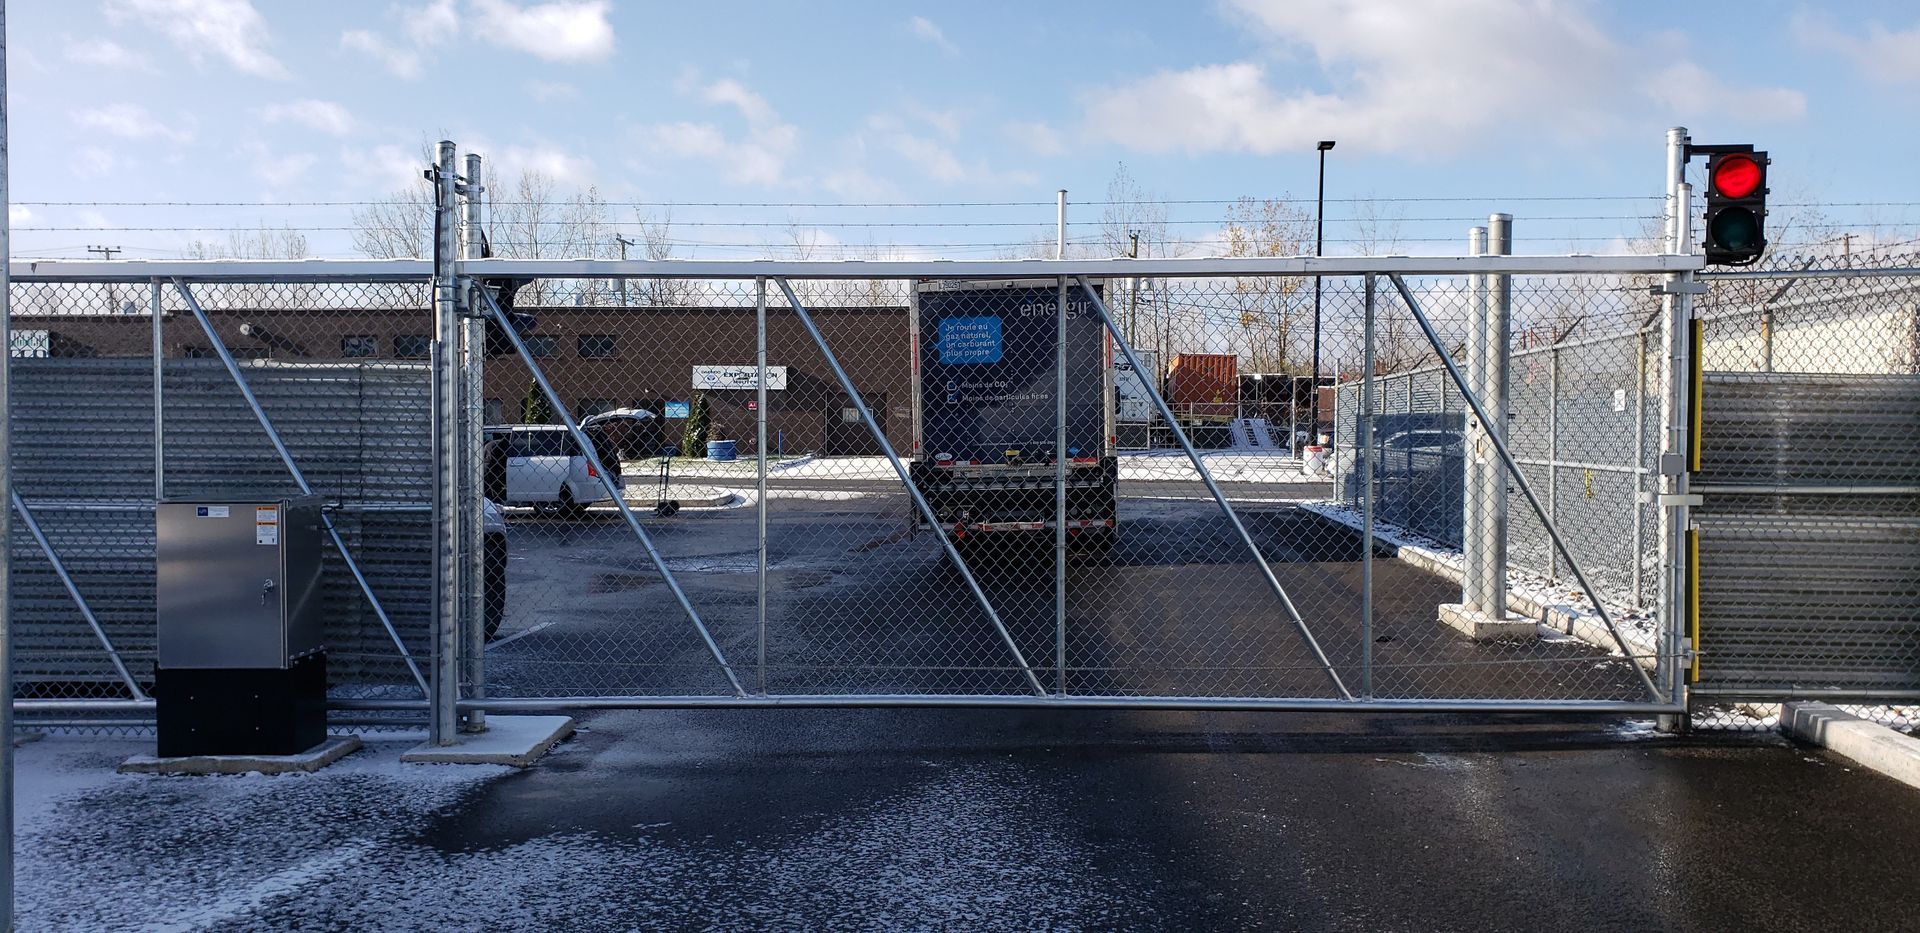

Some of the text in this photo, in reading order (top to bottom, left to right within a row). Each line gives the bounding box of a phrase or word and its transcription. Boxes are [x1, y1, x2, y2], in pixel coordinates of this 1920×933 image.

[945, 333, 959, 341] gaz
[957, 340, 995, 348] carburant
[946, 349, 990, 357] plus propre
[723, 371, 778, 379] EXPORTAON
